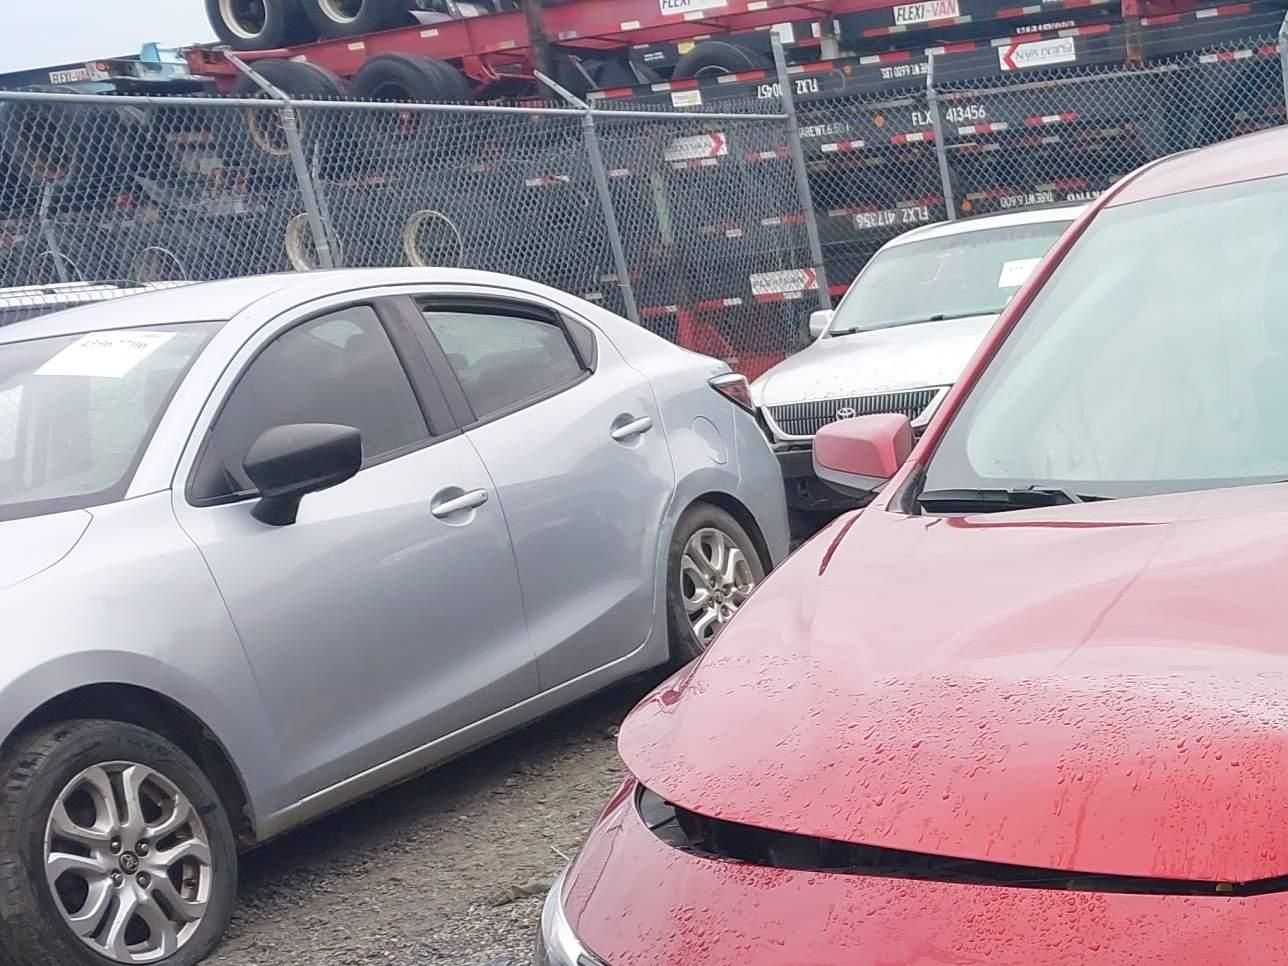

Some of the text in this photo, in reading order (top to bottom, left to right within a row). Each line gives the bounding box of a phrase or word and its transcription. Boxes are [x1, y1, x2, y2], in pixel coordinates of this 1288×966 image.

[896, 3, 957, 22] FLEXI-VAN
[795, 78, 818, 95] FLXZ
[911, 104, 986, 127] FLX 413456
[856, 205, 928, 228] FLXZ 417356
